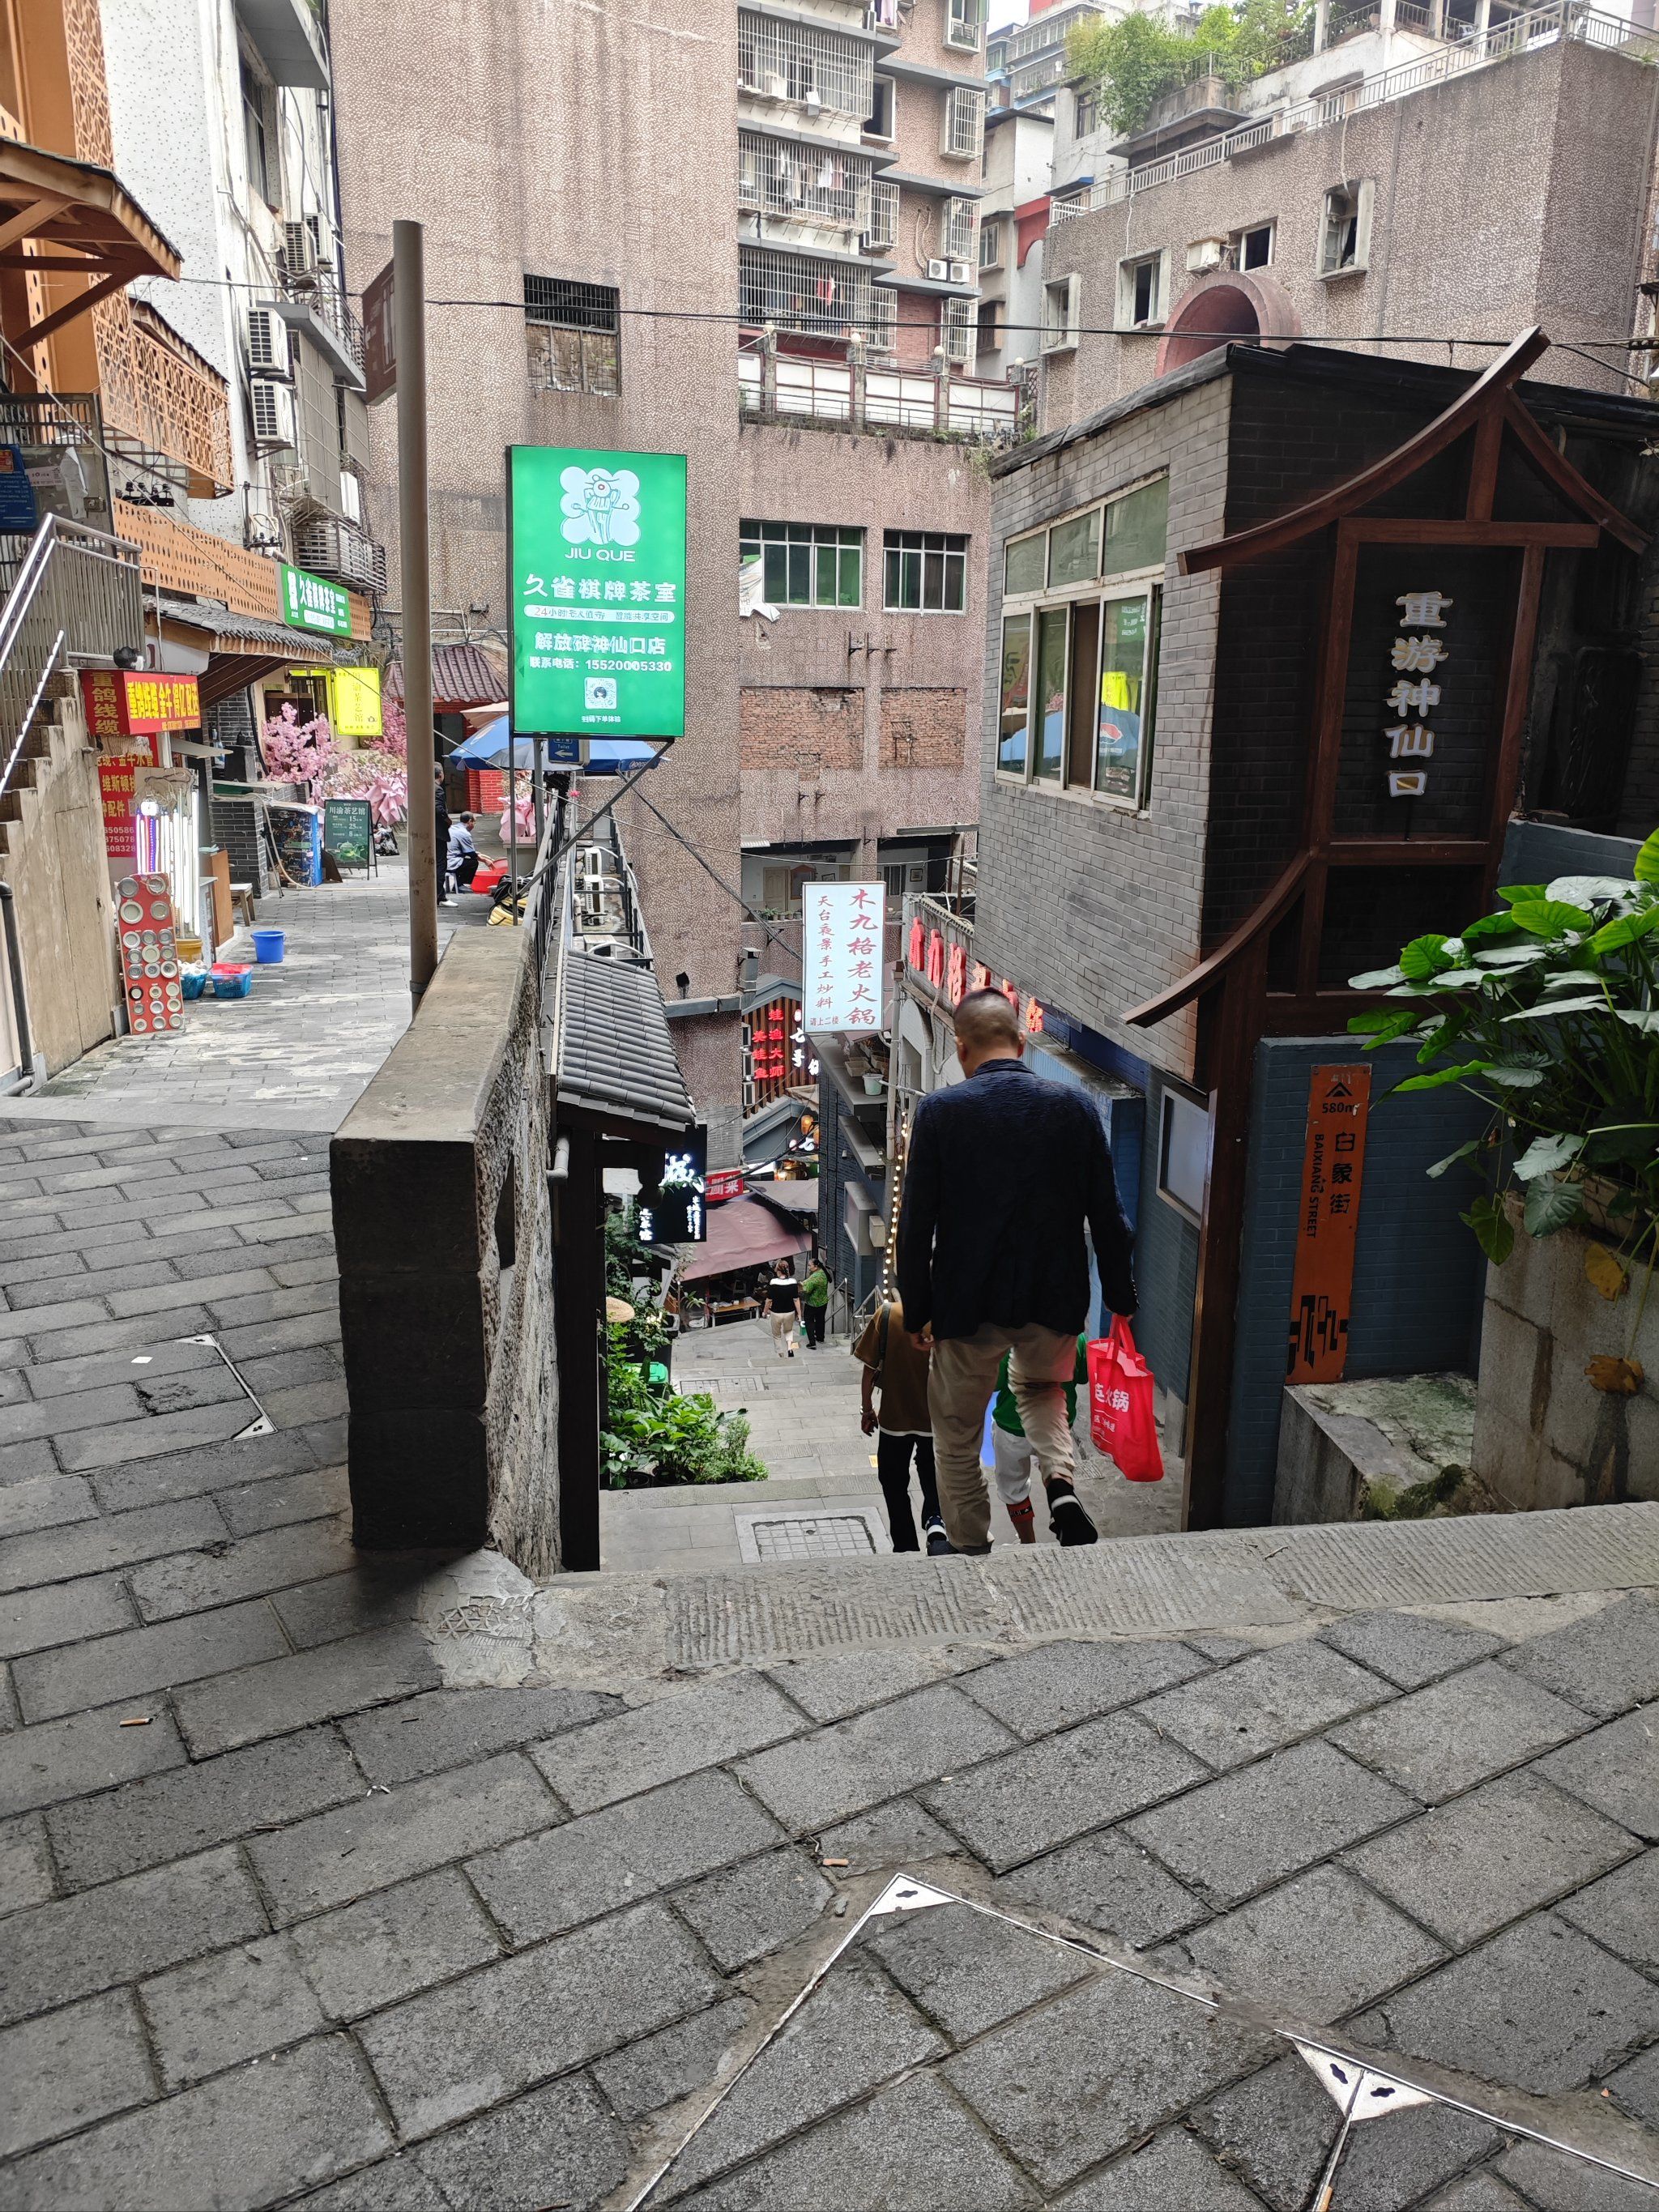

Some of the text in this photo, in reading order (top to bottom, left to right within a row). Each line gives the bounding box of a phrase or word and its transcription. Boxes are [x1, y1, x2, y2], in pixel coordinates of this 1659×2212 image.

[565, 548, 635, 562] JIU QUE
[523, 573, 676, 603] 久雀棋牌茶室
[535, 631, 666, 655] 解放碑神仙口店
[91, 671, 120, 735] 重鸽线缆
[1384, 591, 1453, 797] 重游神仙口
[329, 806, 366, 815] 川渝茶艺馆
[816, 895, 836, 1009] 天台夜景手工炒料
[844, 888, 879, 1025] 木九格老火锅
[810, 1016, 839, 1026] 请上二楼
[1310, 1134, 1324, 1194] BAIXIANG
[1329, 1132, 1356, 1215] 白象街
[1307, 1196, 1320, 1238] STREET
